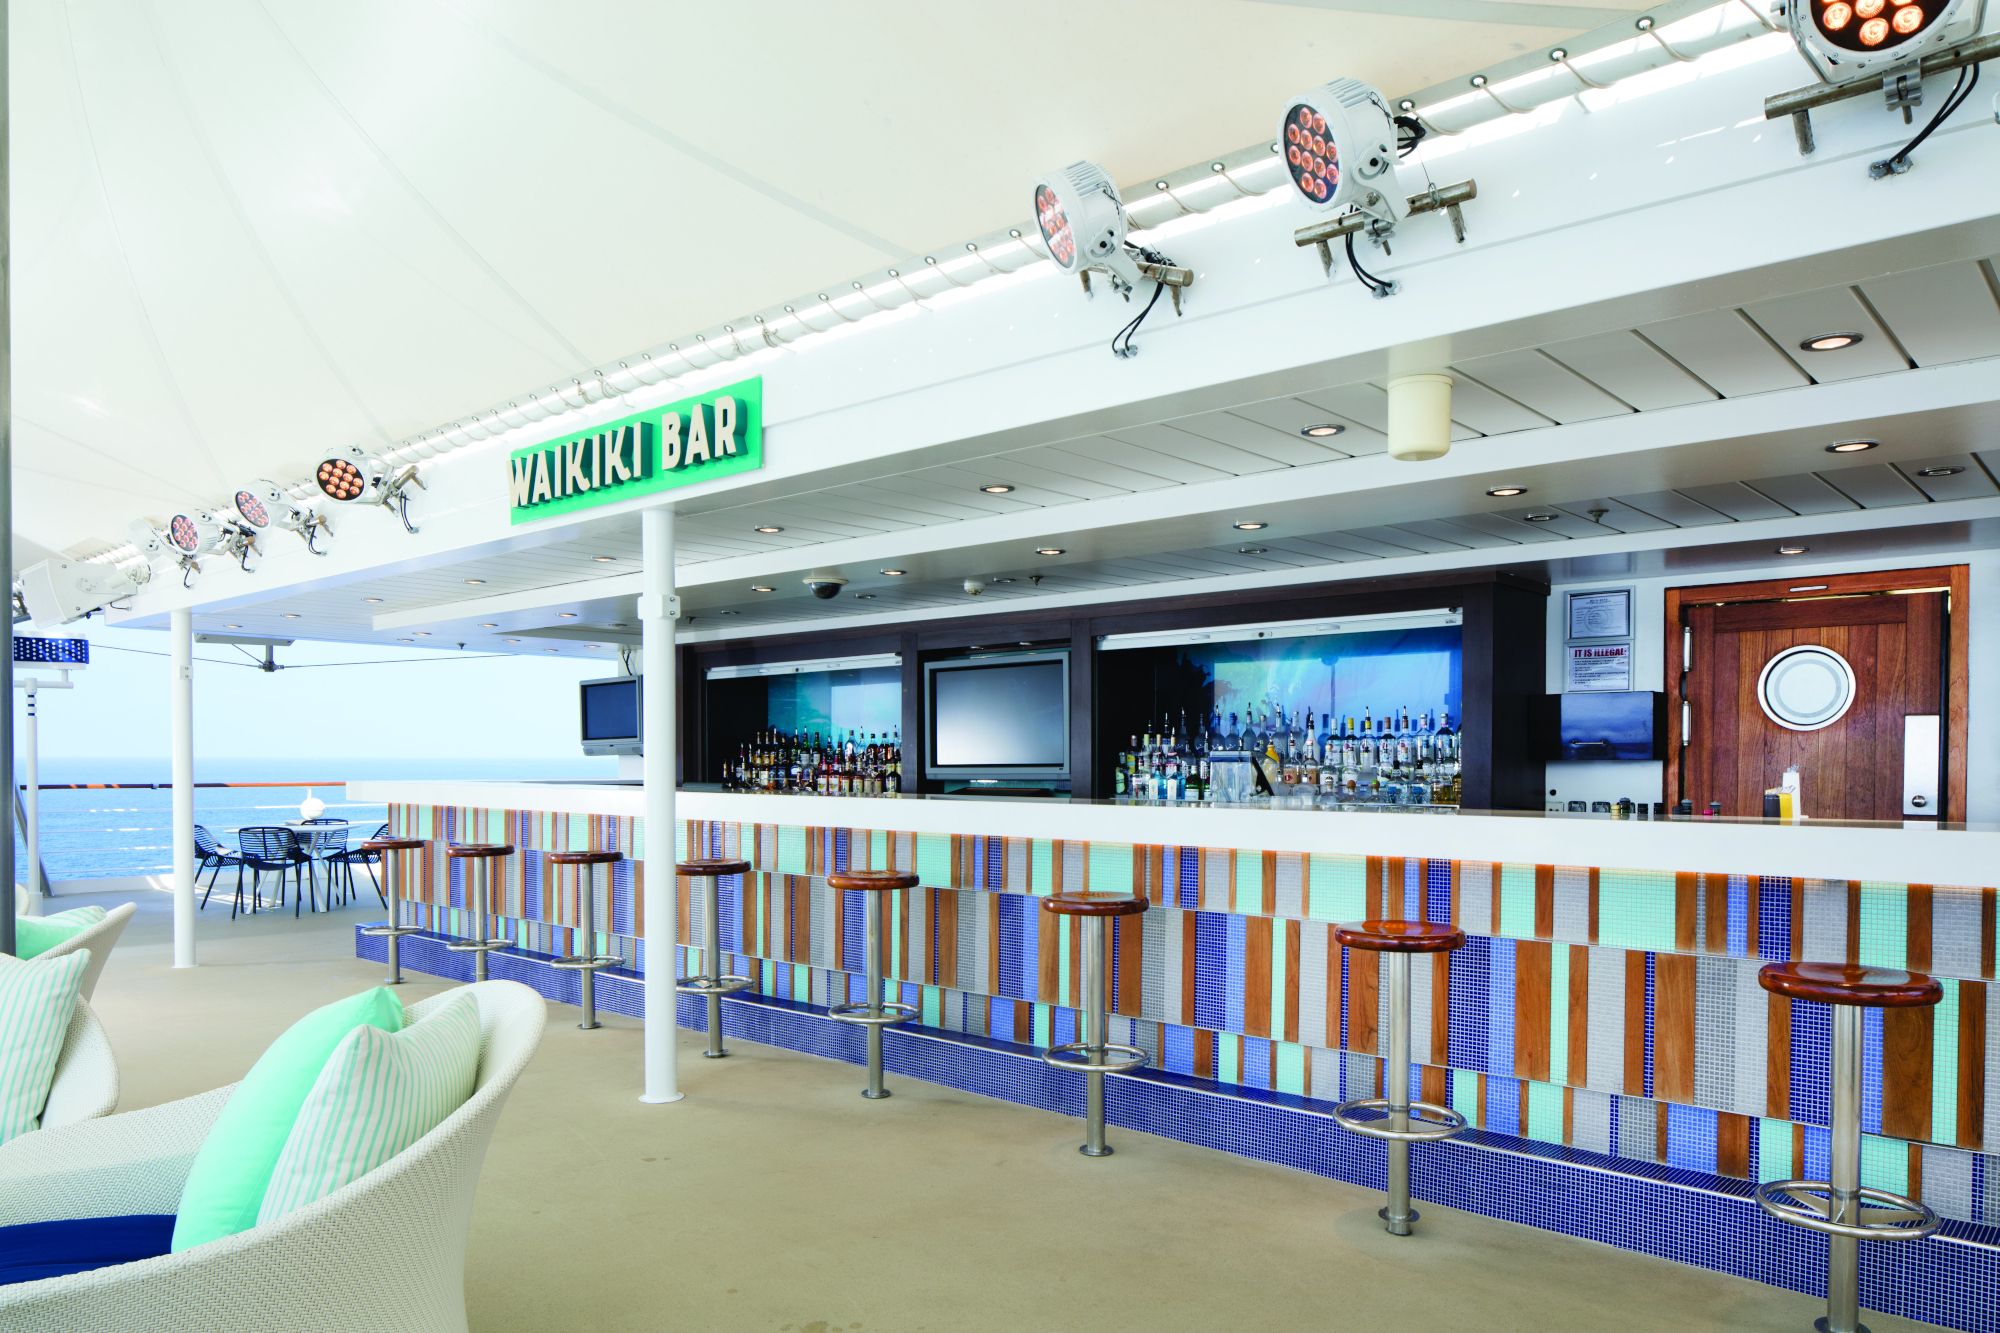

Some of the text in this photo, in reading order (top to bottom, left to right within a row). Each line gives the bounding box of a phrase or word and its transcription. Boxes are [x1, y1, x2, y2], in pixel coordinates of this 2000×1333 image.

[506, 395, 744, 509] WAIKIKI BAR
[1574, 649, 1582, 657] IT
[1584, 649, 1592, 657] IS
